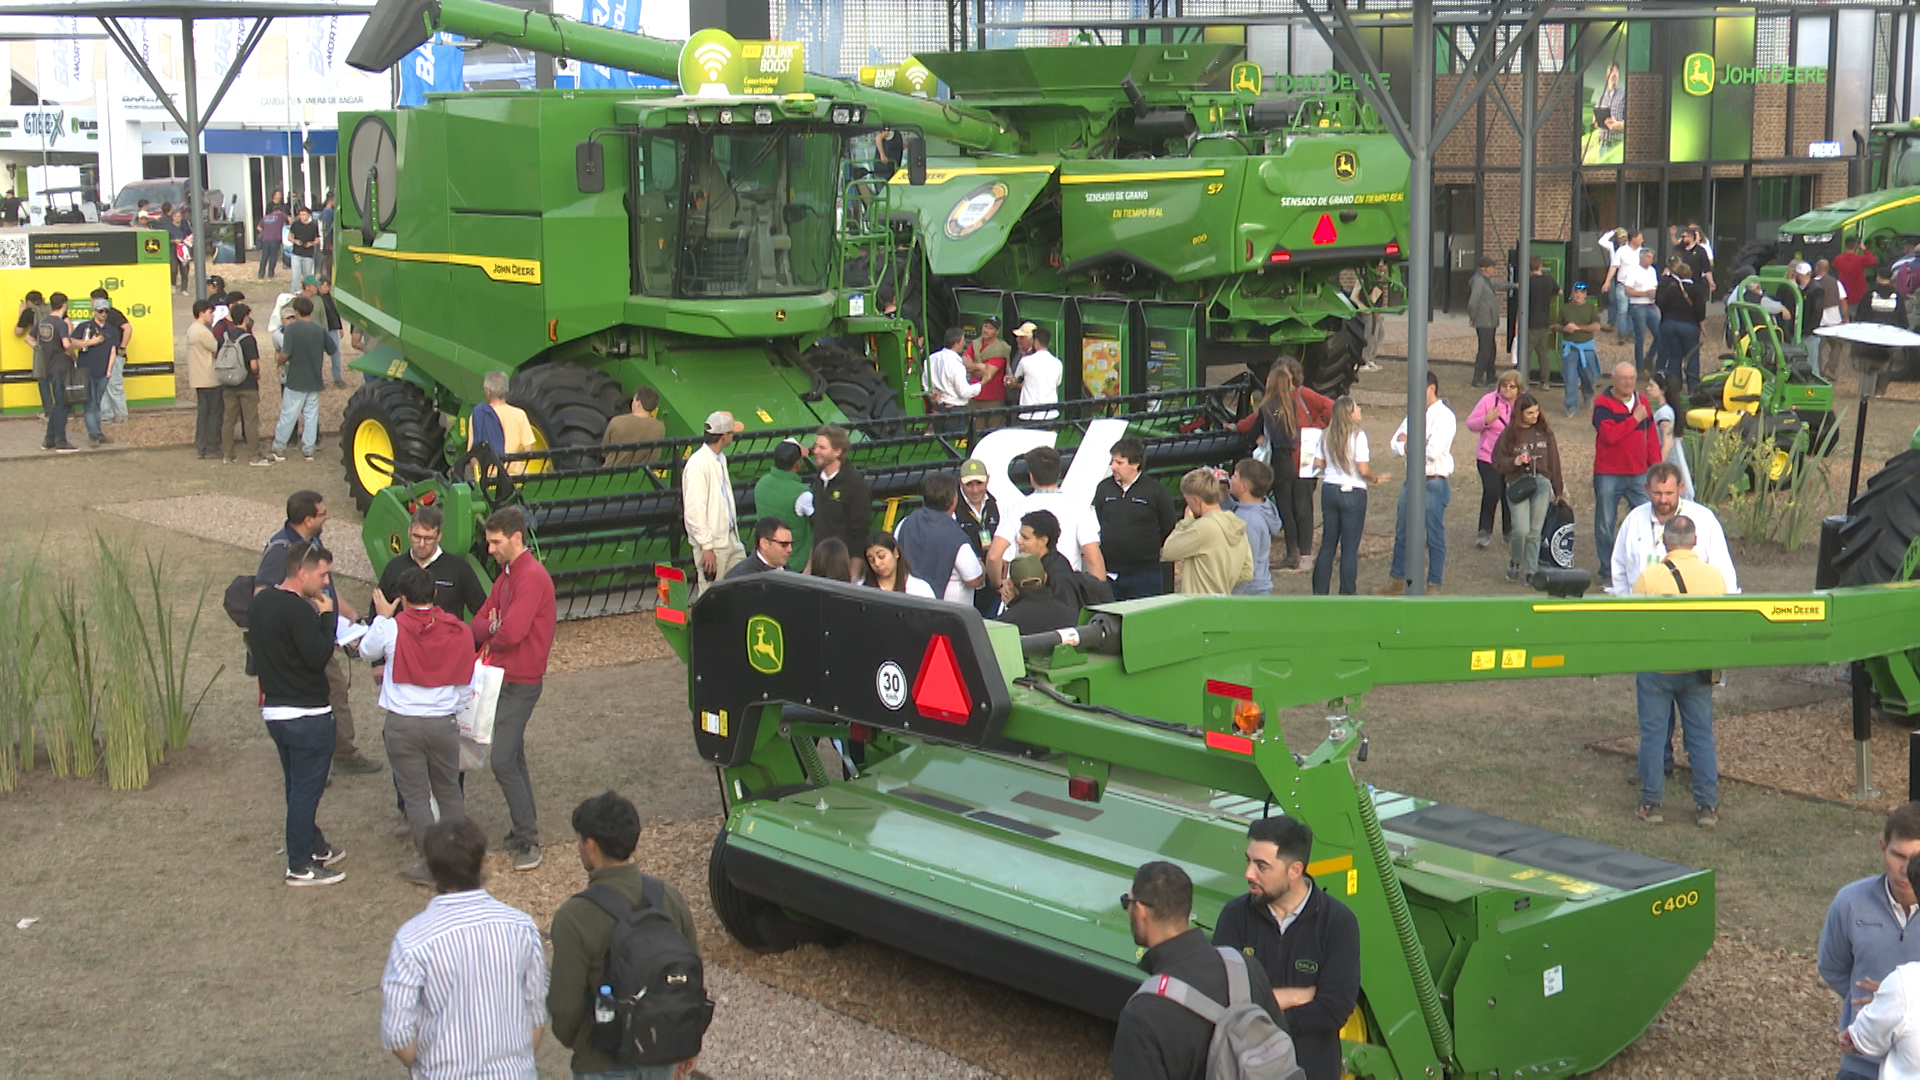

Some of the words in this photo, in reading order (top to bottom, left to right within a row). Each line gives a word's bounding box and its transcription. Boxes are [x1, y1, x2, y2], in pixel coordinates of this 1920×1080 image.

[760, 58, 792, 72] BOOST
[1719, 63, 1767, 85] JOHN
[1770, 63, 1828, 84] DEERE
[1269, 72, 1320, 92] JOHN
[1085, 192, 1114, 202] SENSADO
[1115, 191, 1124, 201] DE
[1125, 191, 1149, 200] GRANO
[1281, 197, 1317, 208] SENSADO
[1317, 196, 1328, 206] DE
[1329, 194, 1354, 205] GRANO
[1354, 194, 1365, 204] EN
[1365, 193, 1390, 204] TIEMPO
[1389, 192, 1405, 202] REAL
[1112, 209, 1122, 219] EN
[1122, 208, 1147, 218] TIEMPO
[1147, 207, 1164, 218] REAL
[492, 263, 511, 275] JOHN
[511, 264, 536, 276] DEERE
[1771, 605, 1793, 616] JOHN
[1793, 605, 1820, 615] DEERE
[883, 671, 900, 692] 30
